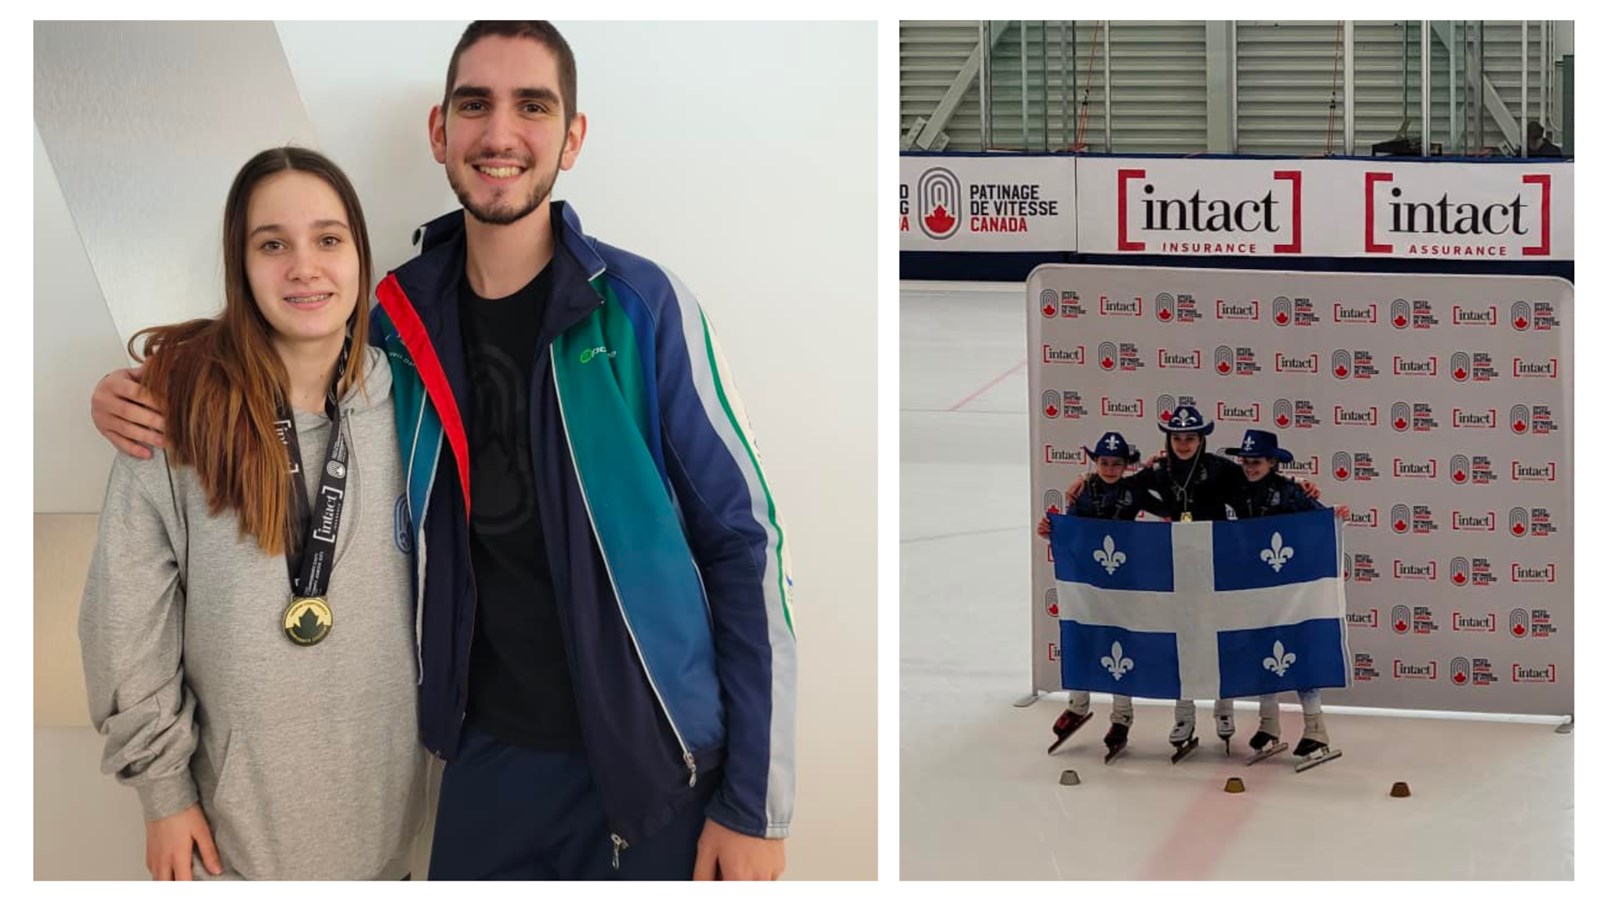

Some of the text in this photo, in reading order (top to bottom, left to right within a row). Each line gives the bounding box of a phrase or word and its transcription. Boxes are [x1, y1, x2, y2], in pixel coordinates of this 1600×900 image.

[970, 184, 1039, 200] PATINAGE
[970, 200, 1058, 217] DE VITESSE
[970, 216, 1027, 232] CANADA
[1161, 241, 1257, 254] INSURANCE
[1408, 243, 1508, 256] ASSURANCE
